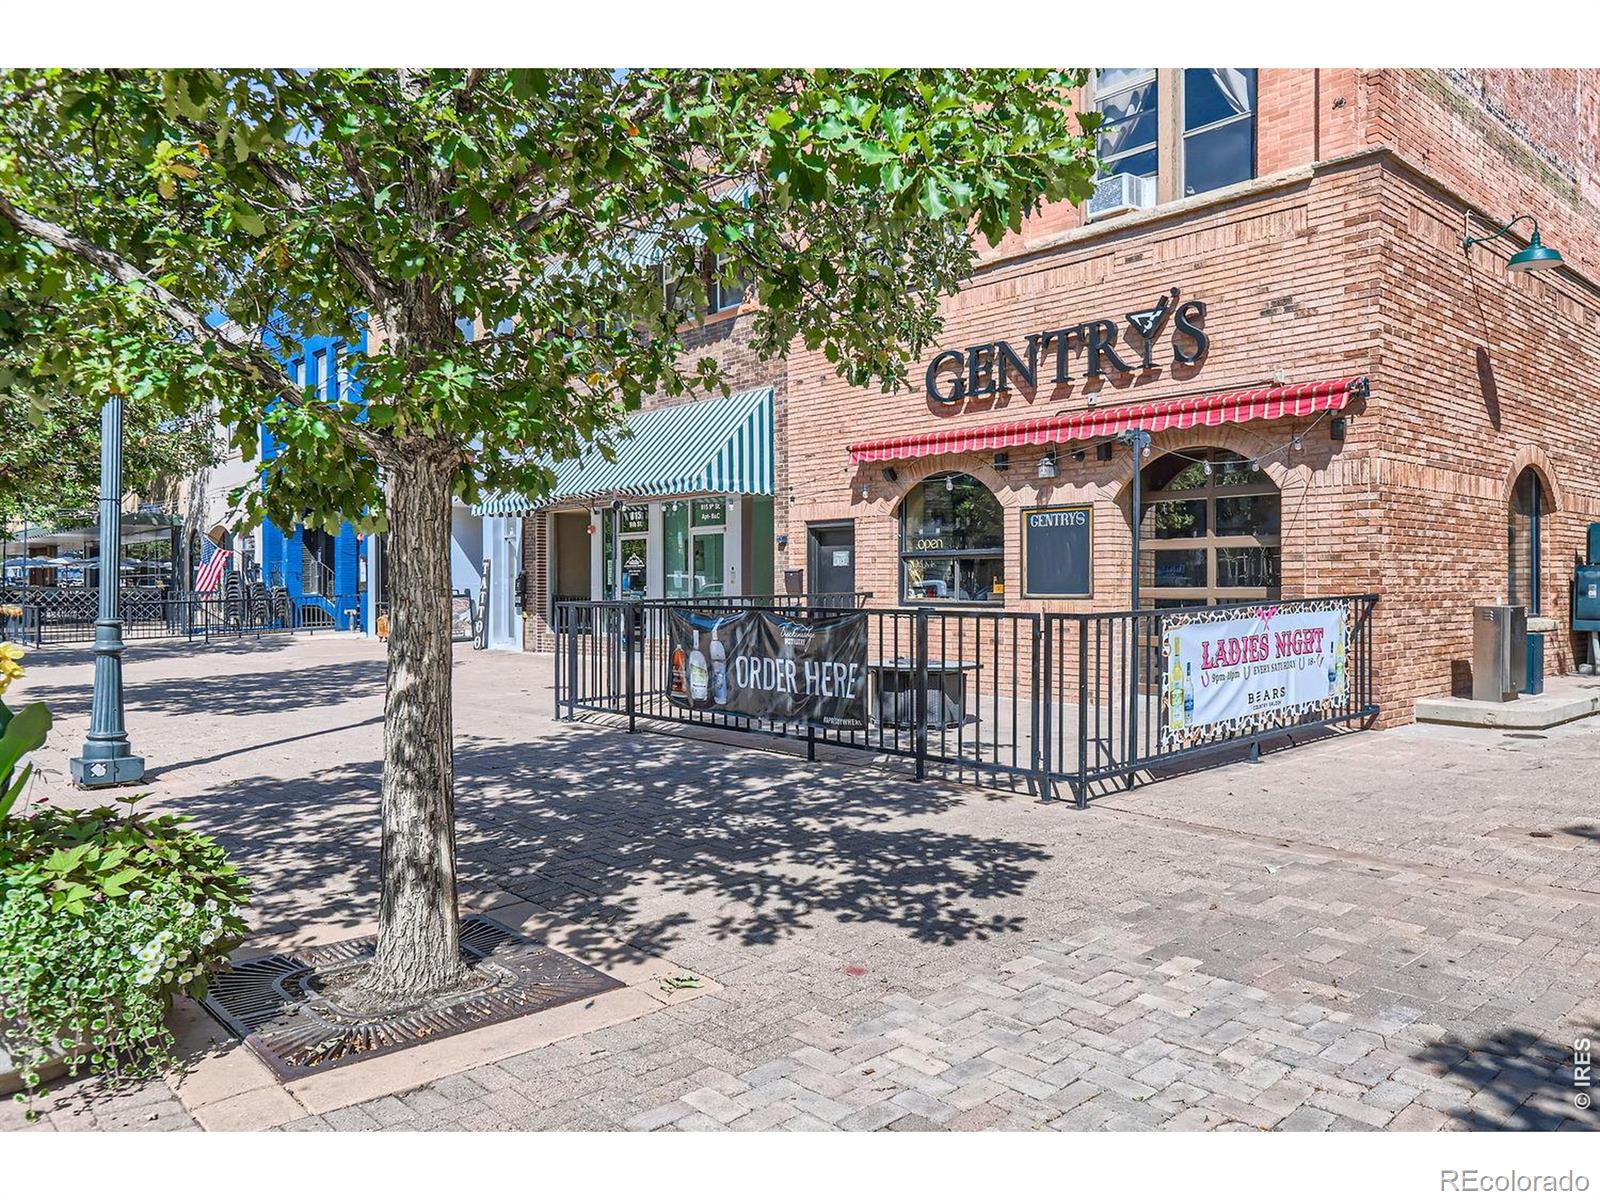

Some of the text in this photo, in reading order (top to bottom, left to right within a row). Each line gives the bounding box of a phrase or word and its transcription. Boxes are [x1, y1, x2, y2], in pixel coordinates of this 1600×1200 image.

[926, 287, 1209, 403] GENTRY'S
[917, 538, 944, 552] open
[473, 562, 489, 648] TATTOO
[1201, 628, 1324, 670] LADIES NIGHT
[1253, 660, 1296, 675] EVERY SATURDAY
[735, 655, 798, 694] ORDER
[804, 661, 858, 699] HERE
[1248, 686, 1286, 704] BEARS
